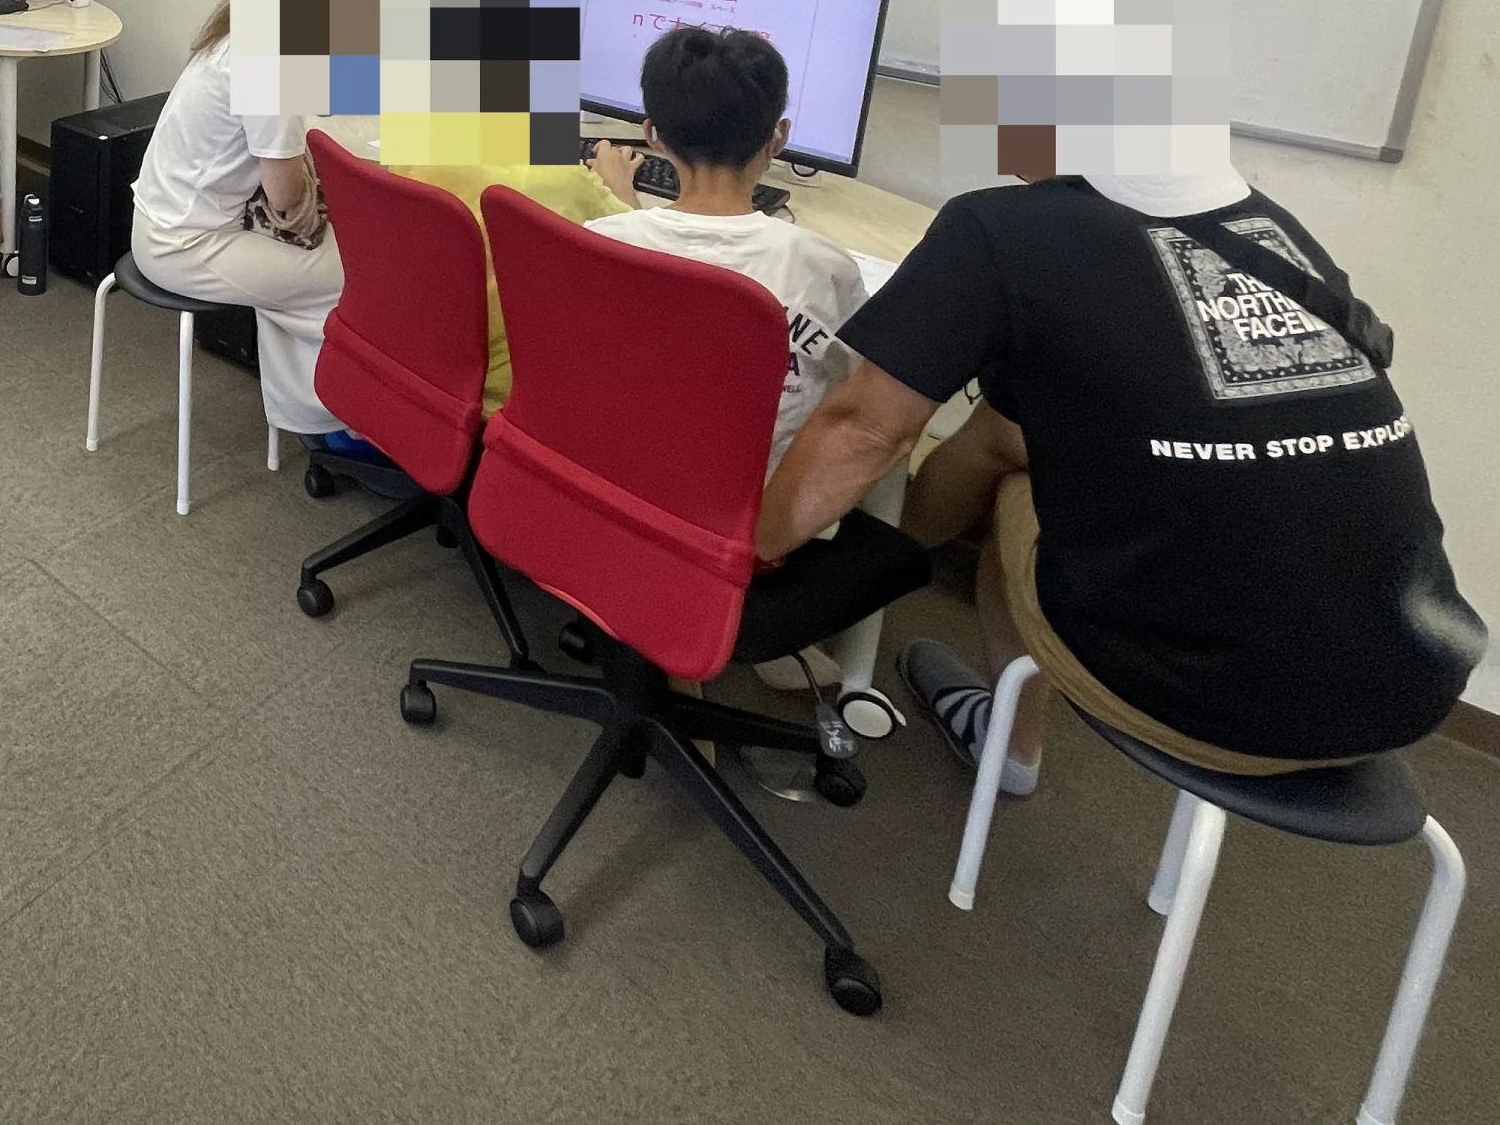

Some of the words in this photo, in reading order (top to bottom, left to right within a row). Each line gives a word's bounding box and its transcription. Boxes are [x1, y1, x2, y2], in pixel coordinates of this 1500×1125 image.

[1196, 291, 1300, 322] NORTH
[1233, 311, 1306, 342] FACE
[1150, 439, 1257, 460] NEVER
[1266, 434, 1334, 458] STOP
